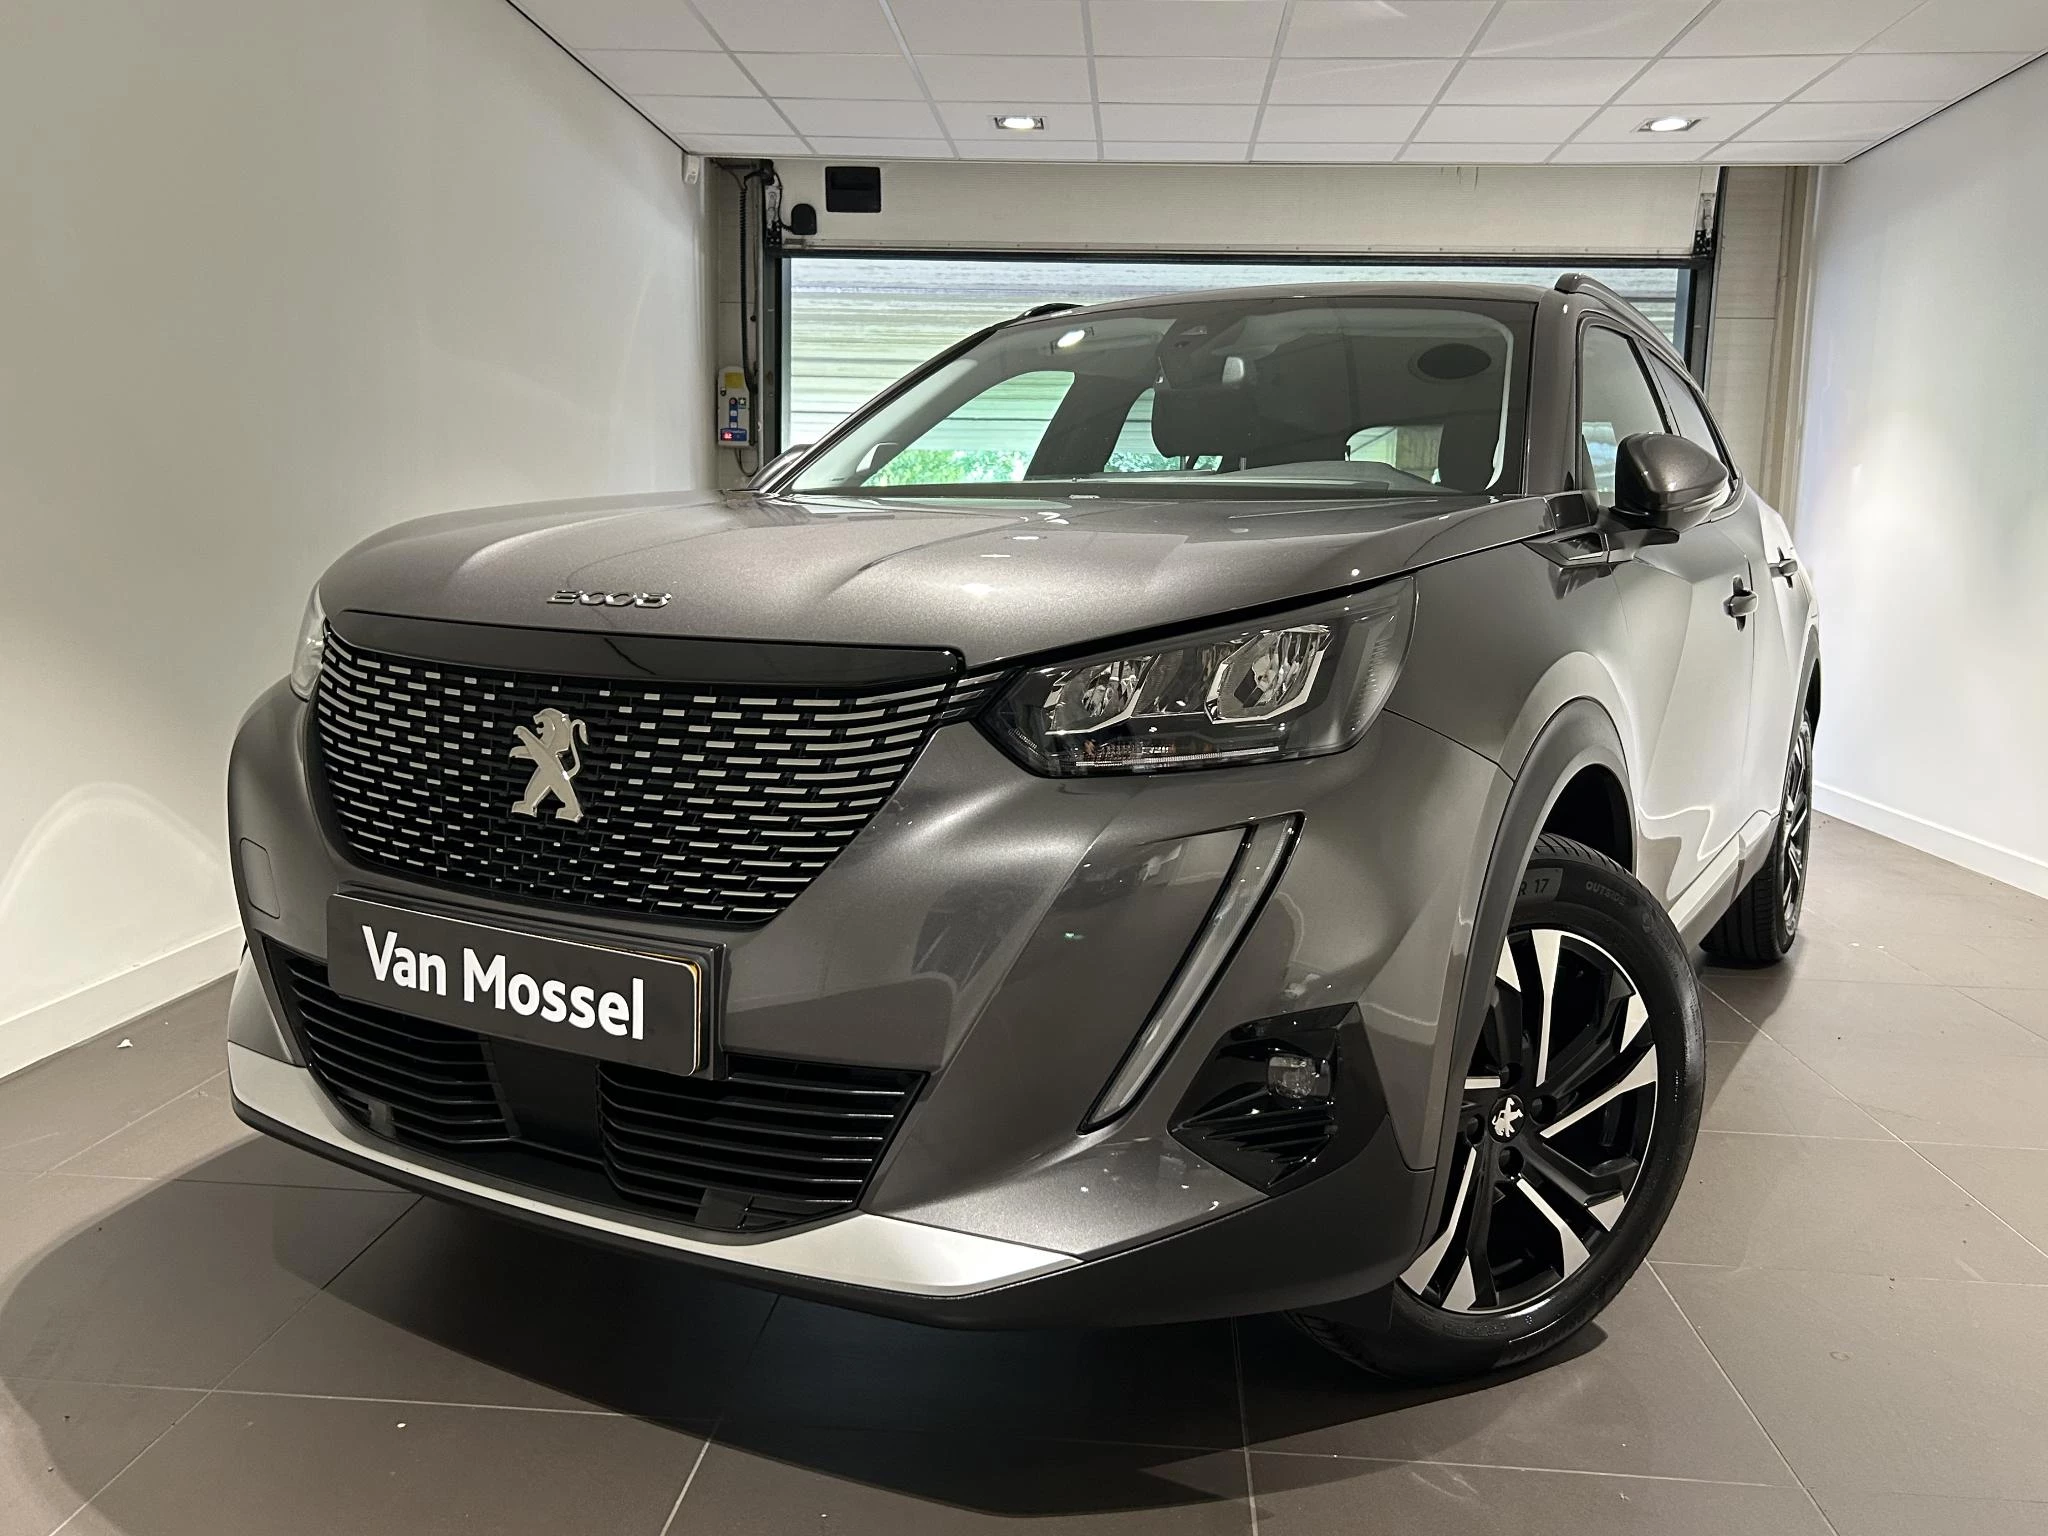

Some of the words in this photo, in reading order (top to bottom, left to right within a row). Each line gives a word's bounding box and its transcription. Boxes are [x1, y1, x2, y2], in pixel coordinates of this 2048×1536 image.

[546, 589, 672, 609] 2008
[1518, 881, 1528, 896] R
[1534, 878, 1550, 894] 17
[361, 924, 447, 996] Van
[463, 947, 644, 1040] Mossel
